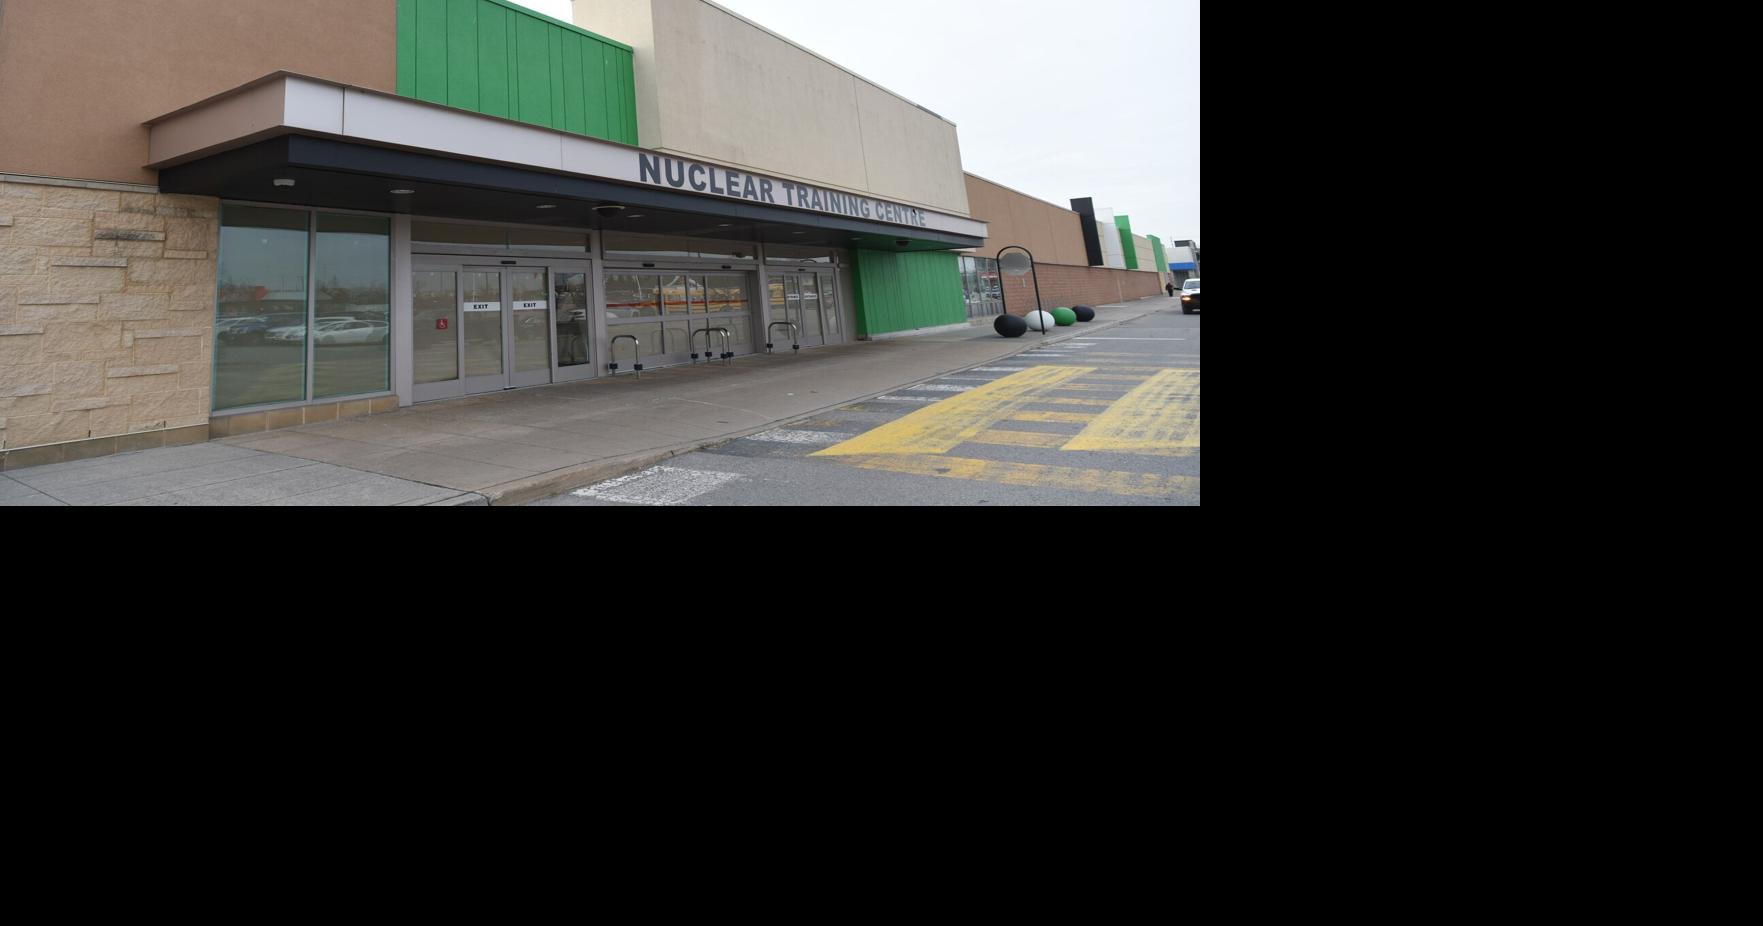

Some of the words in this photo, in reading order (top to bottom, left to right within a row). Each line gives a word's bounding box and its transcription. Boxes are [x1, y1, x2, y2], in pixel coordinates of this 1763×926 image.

[638, 153, 775, 203] NUCLEAR
[782, 182, 871, 219] TRAINING
[875, 201, 926, 227] CENTRE
